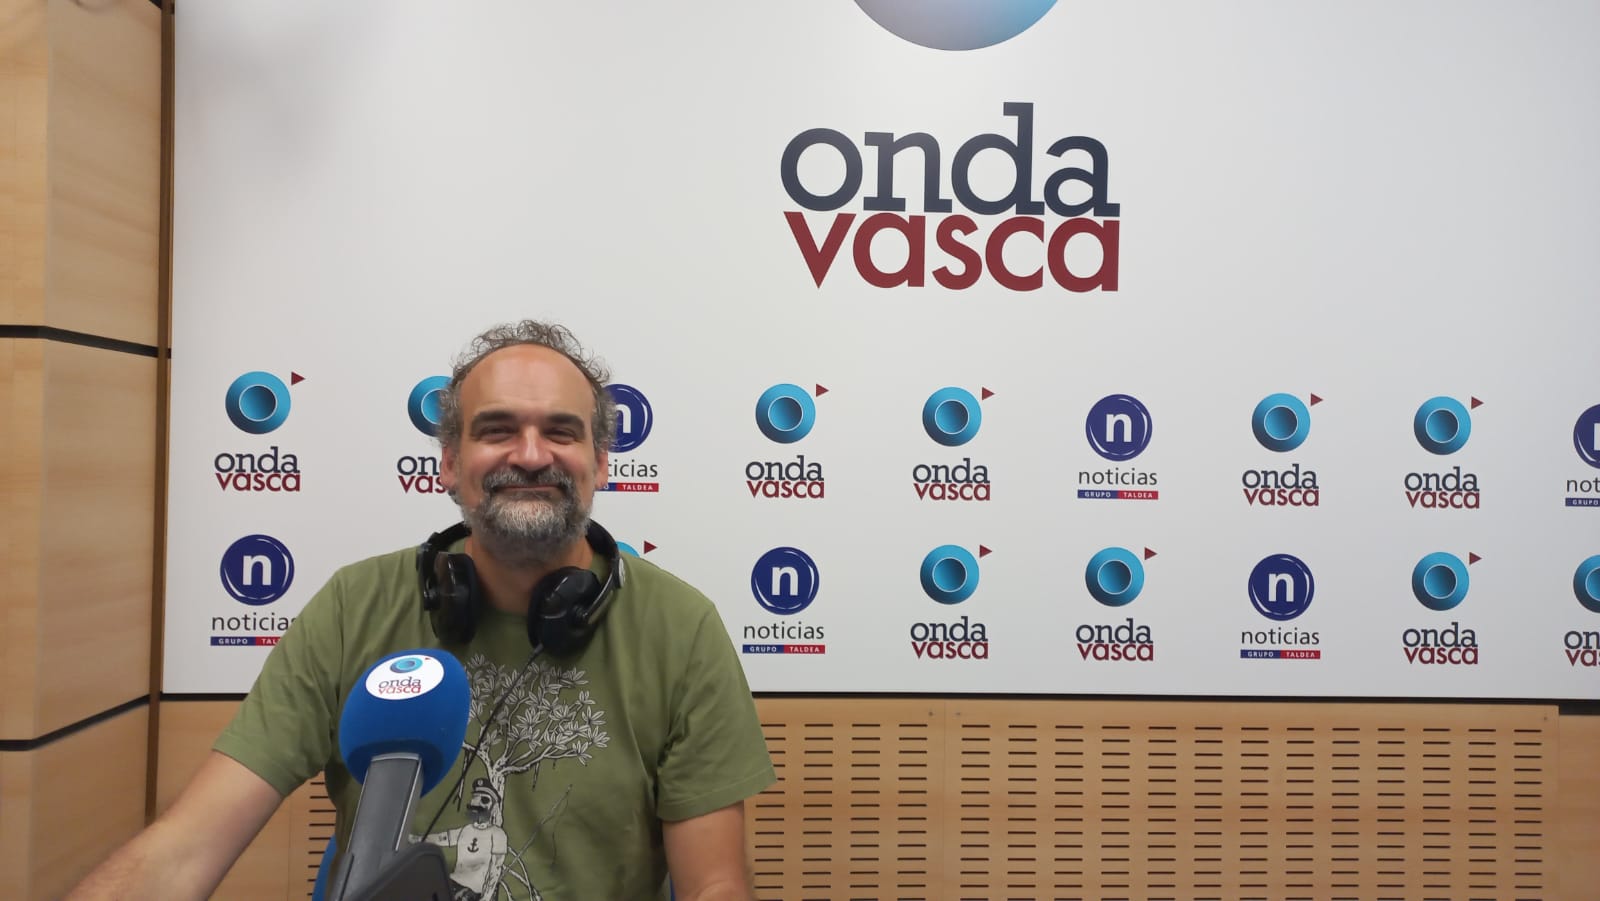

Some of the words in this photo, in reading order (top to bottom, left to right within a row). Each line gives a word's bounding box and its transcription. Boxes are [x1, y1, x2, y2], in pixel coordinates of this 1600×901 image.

[781, 102, 1120, 217] onda
[784, 211, 1120, 292] vasca
[1106, 413, 1132, 442] n
[214, 446, 300, 474] onda
[397, 455, 442, 476] on
[608, 459, 658, 478] icias
[745, 455, 824, 483] onda
[912, 457, 990, 485] onda
[1078, 468, 1158, 486] noticias
[1242, 464, 1319, 490] onda
[1404, 466, 1479, 493] onda
[216, 471, 301, 493] vasca
[398, 475, 447, 494] vas
[747, 479, 824, 499] vasca
[913, 482, 990, 502] vasca
[1122, 491, 1154, 499] TALDEA
[1244, 487, 1319, 507] vasca
[1406, 490, 1479, 509] vasca
[243, 555, 272, 586] n
[772, 566, 798, 596] n
[1268, 573, 1294, 602] n
[743, 622, 825, 640] noticias
[910, 616, 988, 645] onda
[1075, 618, 1153, 646] onda
[1241, 627, 1320, 646] noticias
[1403, 622, 1478, 650] onda
[1564, 630, 1600, 650] on
[218, 637, 248, 645] GRUPO
[912, 641, 988, 660] vasca
[1077, 643, 1153, 662] vasca
[1405, 646, 1478, 666] vasca
[378, 676, 421, 688] onda
[378, 685, 422, 695] vasca
